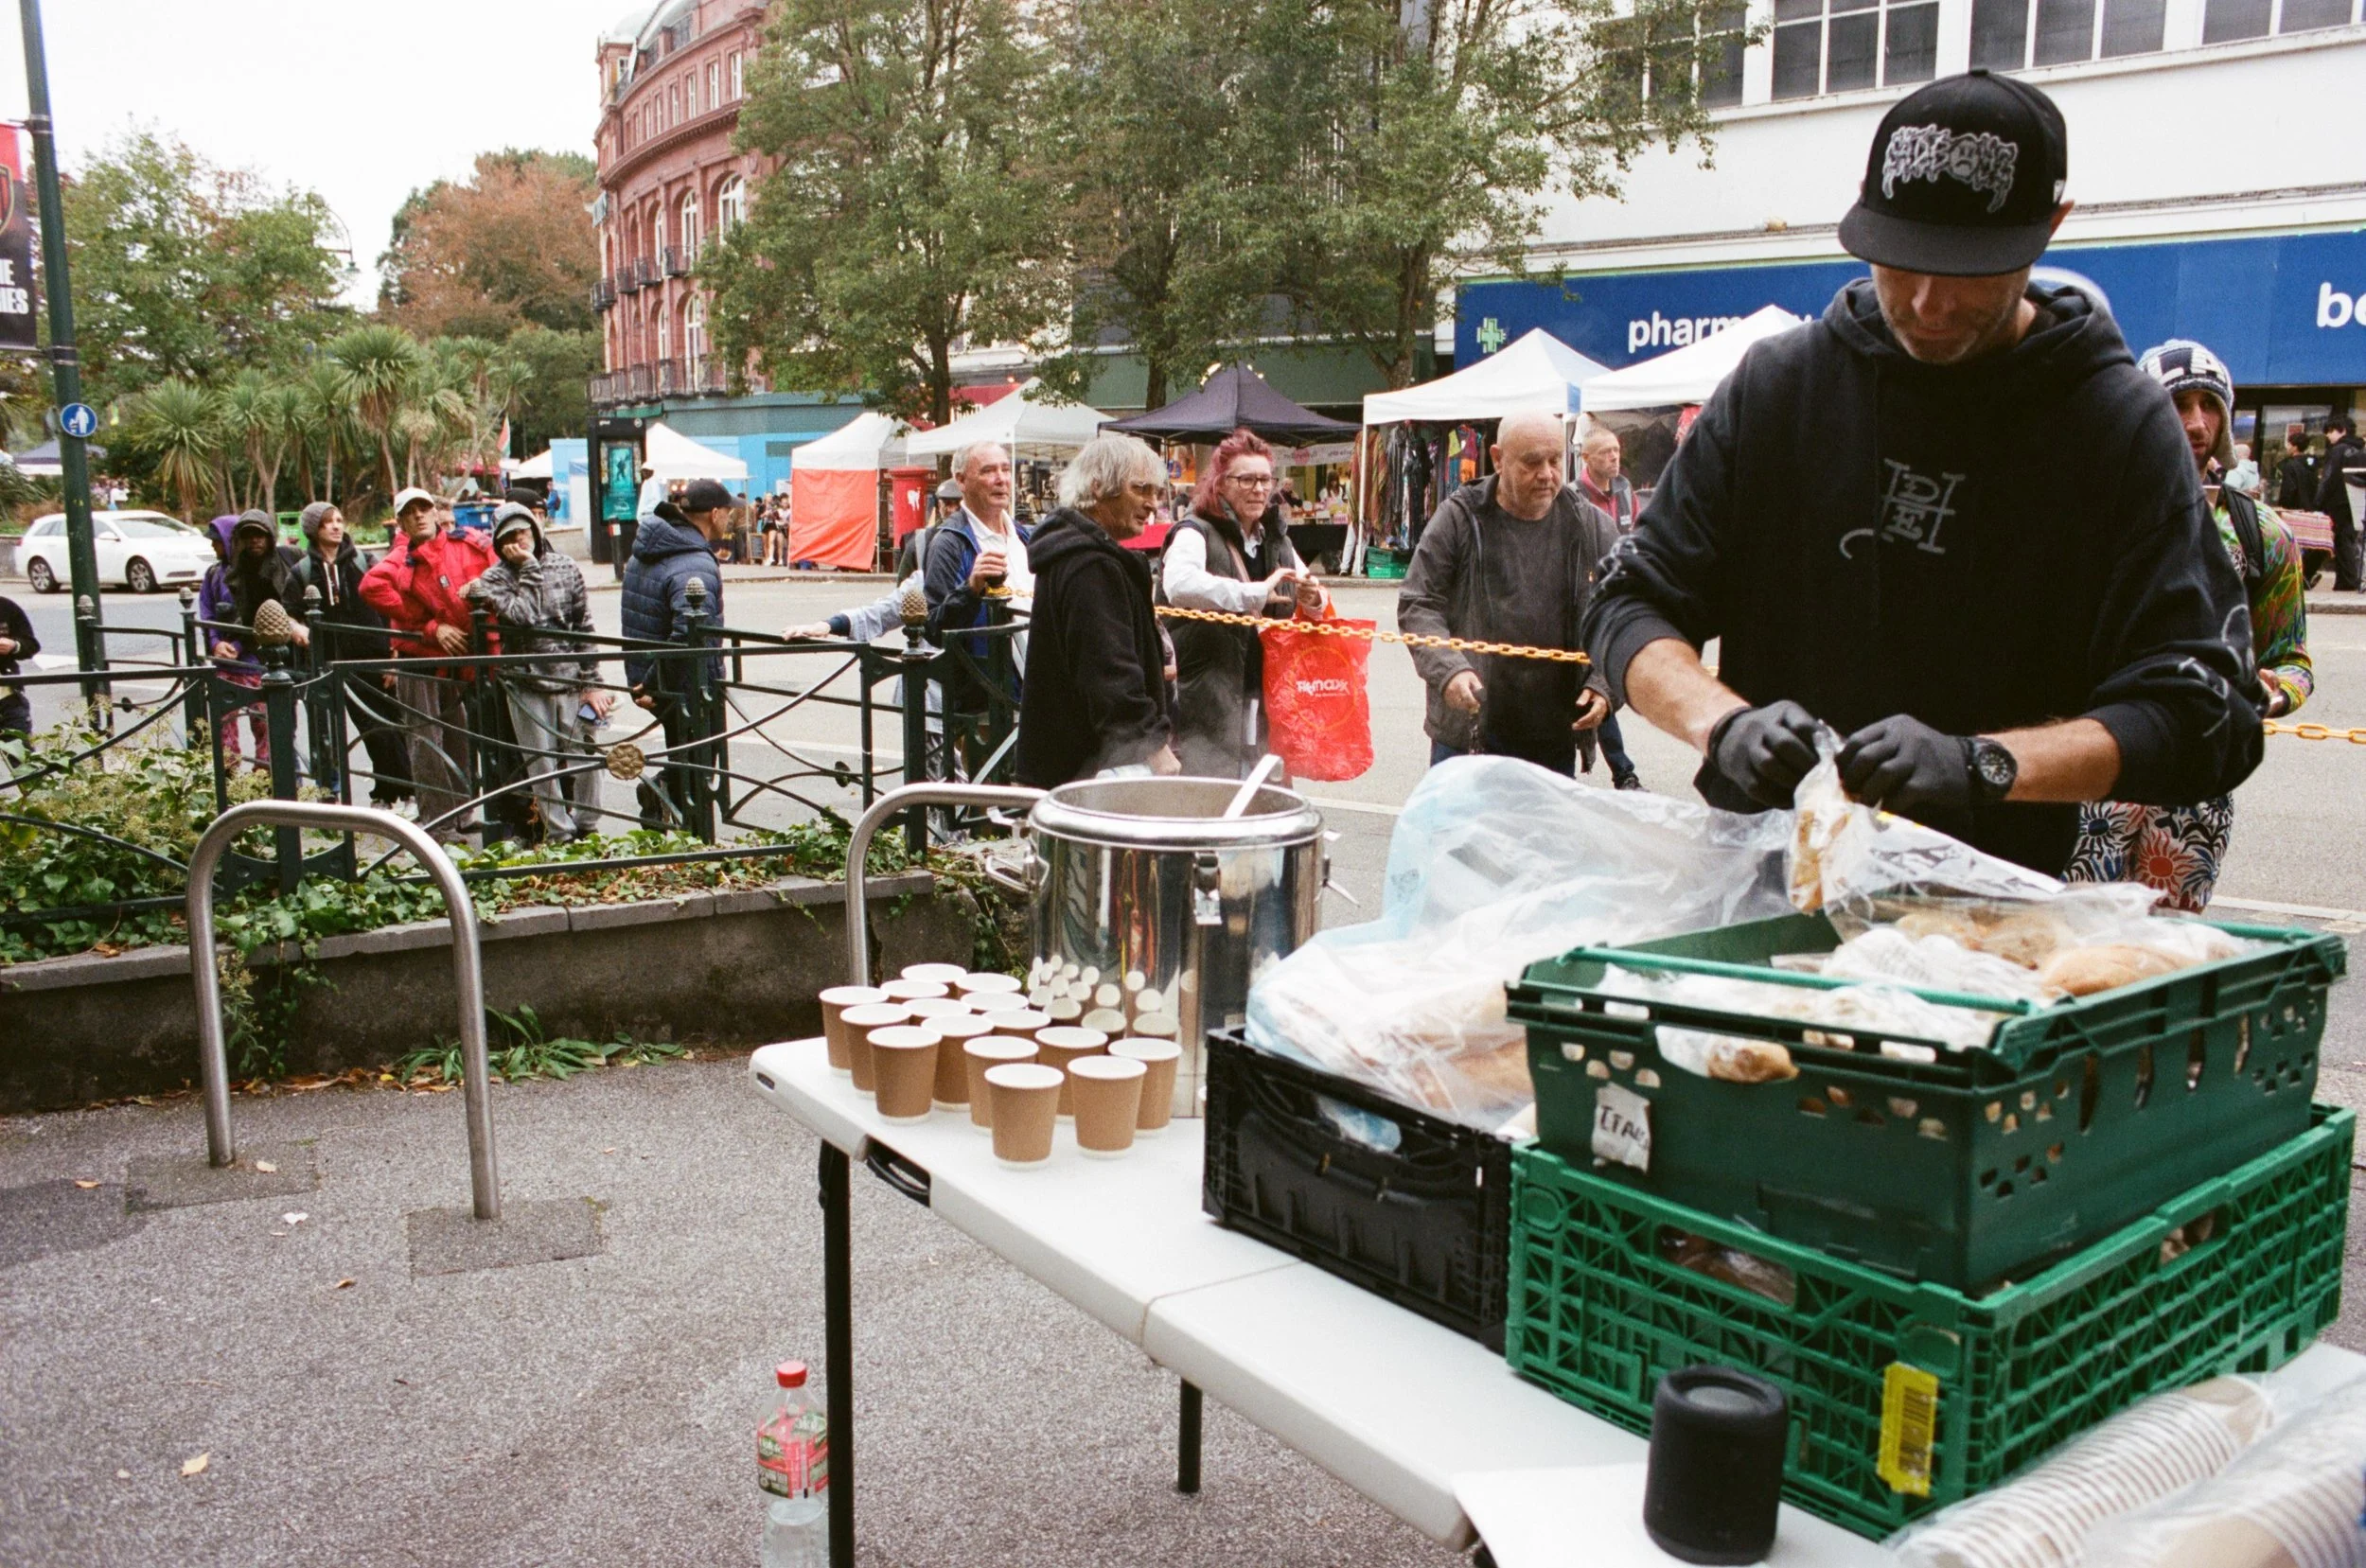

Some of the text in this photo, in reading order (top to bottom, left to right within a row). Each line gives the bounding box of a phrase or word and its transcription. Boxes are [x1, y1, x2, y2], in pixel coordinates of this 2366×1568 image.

[0, 258, 15, 286] E
[0, 287, 28, 314] IES
[1628, 310, 1812, 354] phar
